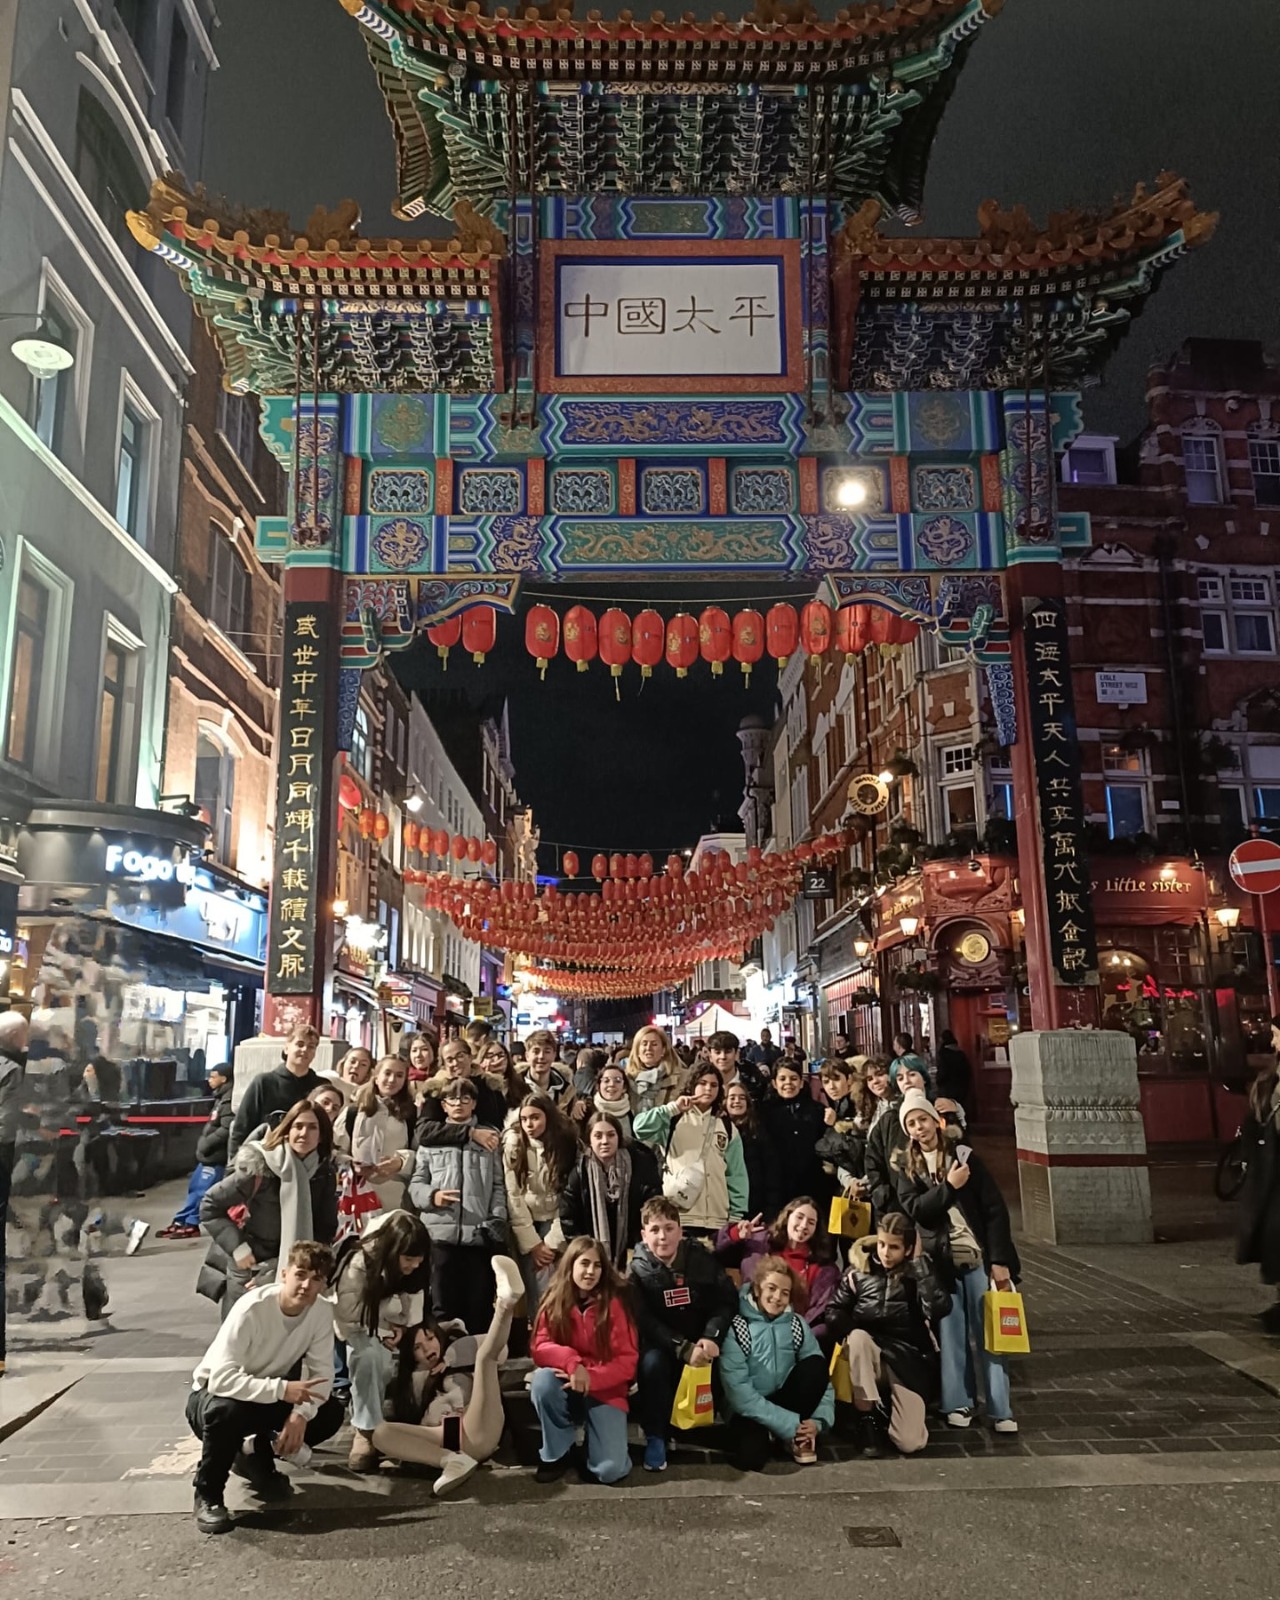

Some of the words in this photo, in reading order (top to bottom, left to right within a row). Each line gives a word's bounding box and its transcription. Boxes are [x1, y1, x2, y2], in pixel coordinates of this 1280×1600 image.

[1100, 681, 1123, 689] STREET
[105, 845, 174, 881] Fogo
[810, 877, 826, 889] 22
[1002, 1316, 1020, 1327] LEGO
